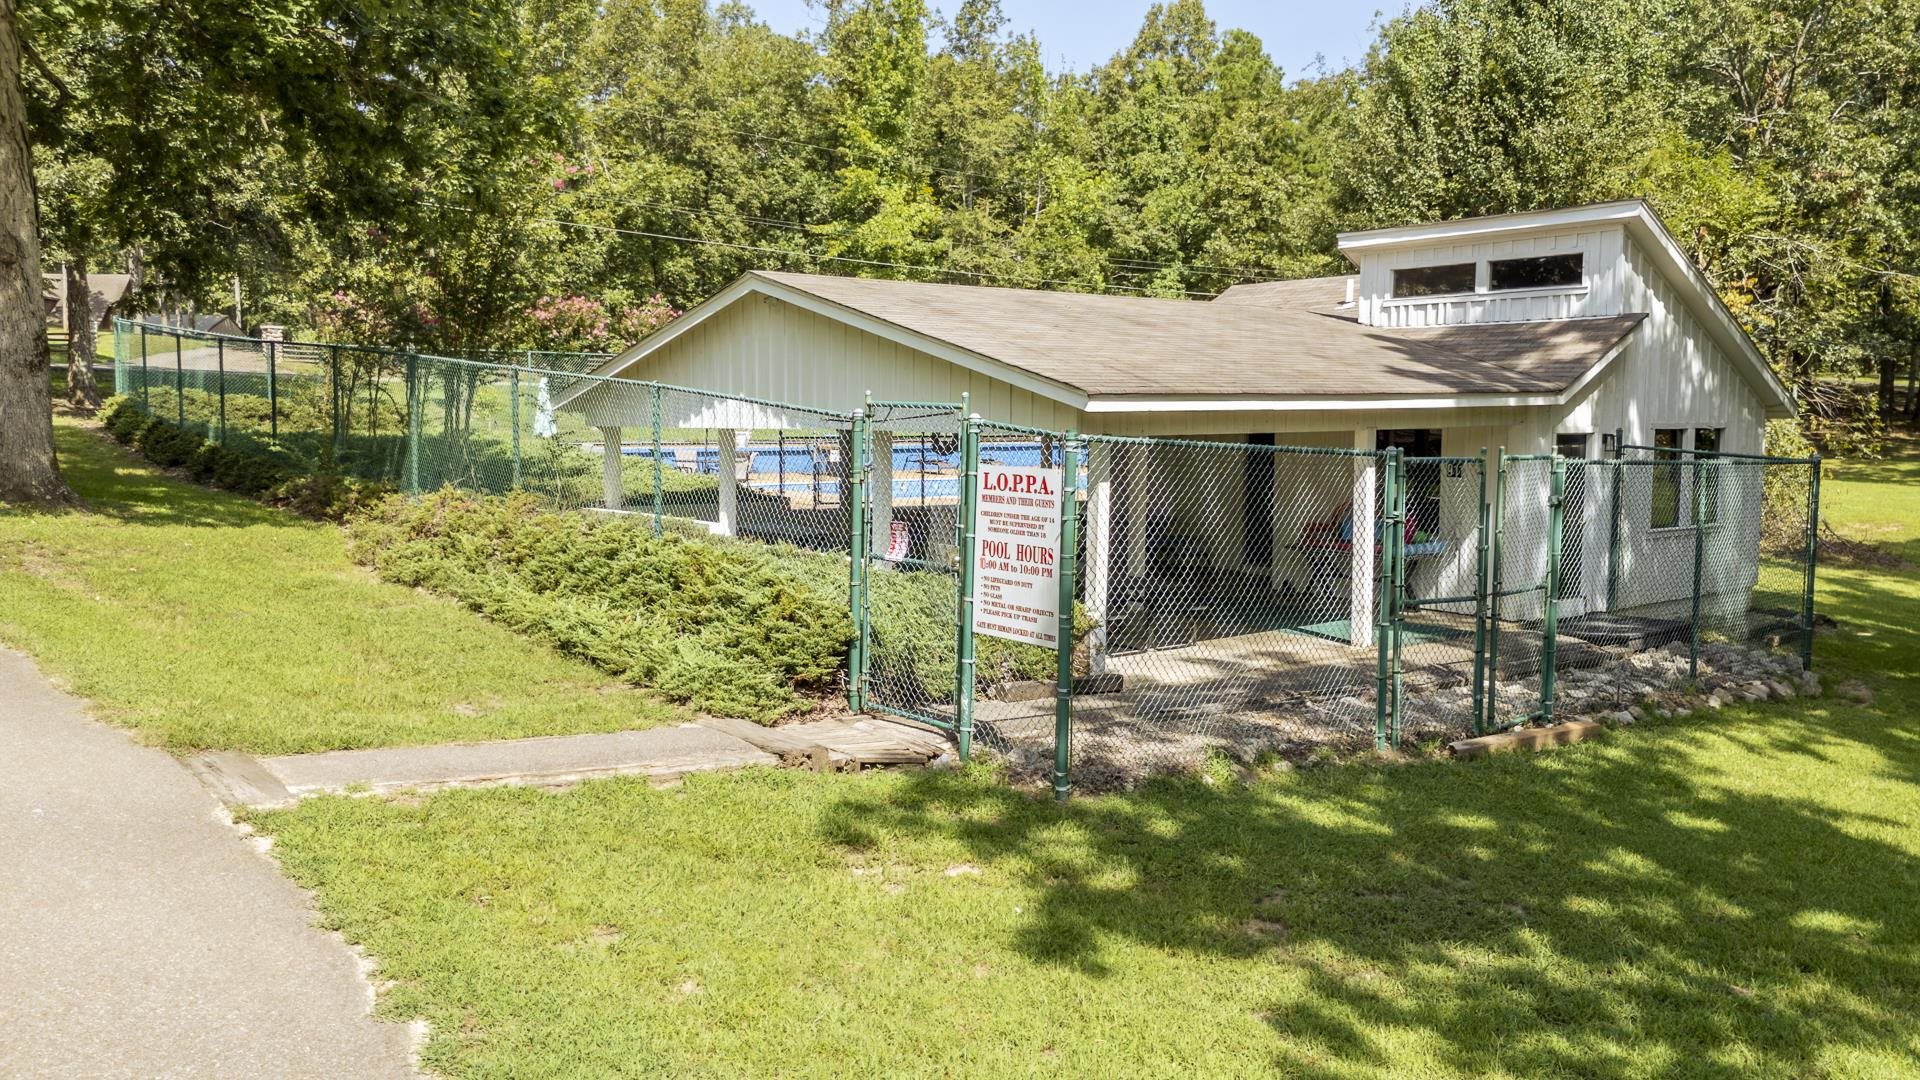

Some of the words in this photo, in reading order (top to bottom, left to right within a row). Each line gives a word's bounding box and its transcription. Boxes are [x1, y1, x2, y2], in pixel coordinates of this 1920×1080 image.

[983, 472, 1054, 495] L.O.P.P.A.
[982, 494, 1004, 503] MEMBERS
[1018, 498, 1033, 506] THEIR
[1035, 500, 1054, 508] GUESTS
[1010, 521, 1037, 529] SUPERVISED
[982, 540, 1010, 559] POOL
[1017, 544, 1054, 565] HOURS
[999, 562, 1008, 571] AM
[1020, 565, 1039, 576] 10:00
[1042, 567, 1052, 578] PM
[991, 577, 1013, 586] LIFEGUARD
[983, 608, 1000, 616] PLEASE
[1033, 608, 1054, 617] OBJECTS
[998, 624, 1012, 634] REMAIN
[1013, 627, 1028, 636] LOCKED
